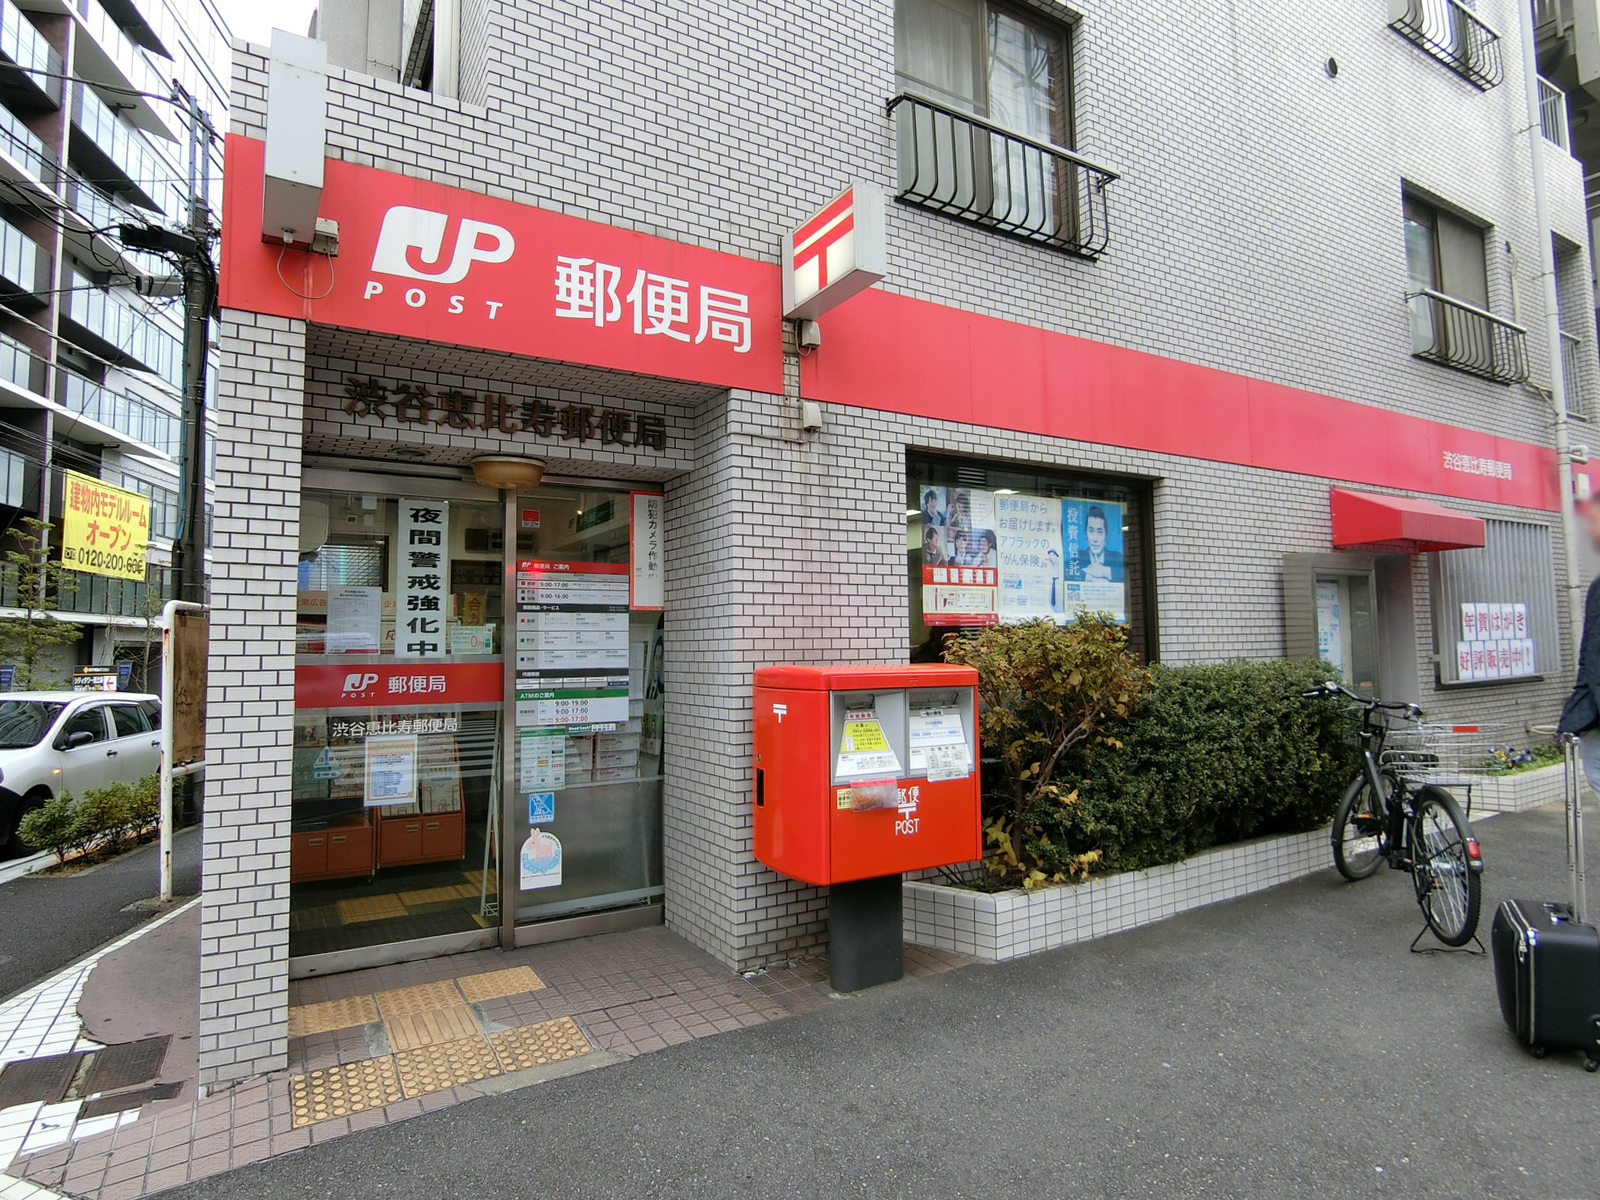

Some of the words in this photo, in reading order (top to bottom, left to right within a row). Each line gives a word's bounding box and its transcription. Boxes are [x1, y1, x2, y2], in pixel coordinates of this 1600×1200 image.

[371, 205, 515, 284] JP
[364, 281, 503, 320] POST
[555, 255, 752, 354] 郵便局
[344, 377, 667, 450] 渋谷恵比寿郵便局
[1442, 450, 1512, 480] 渋谷恵比寿郵便局
[70, 481, 147, 528] 建物内モデルルーム
[999, 498, 1047, 513] 郵便局から
[86, 520, 131, 551] オープン
[999, 518, 1056, 533] お届けします。
[1000, 536, 1050, 549] アフラックの
[1066, 507, 1080, 575] 投資信託
[407, 508, 442, 656] 夜間警戒強化中
[1465, 612, 1525, 632] 年賀はがき
[1459, 648, 1531, 671] 好評販売中！
[343, 673, 379, 692] JP
[388, 675, 447, 694] 郵便局
[341, 691, 376, 699] POST
[332, 718, 458, 738] 渋谷恵比寿郵便局
[895, 818, 920, 836] POST
